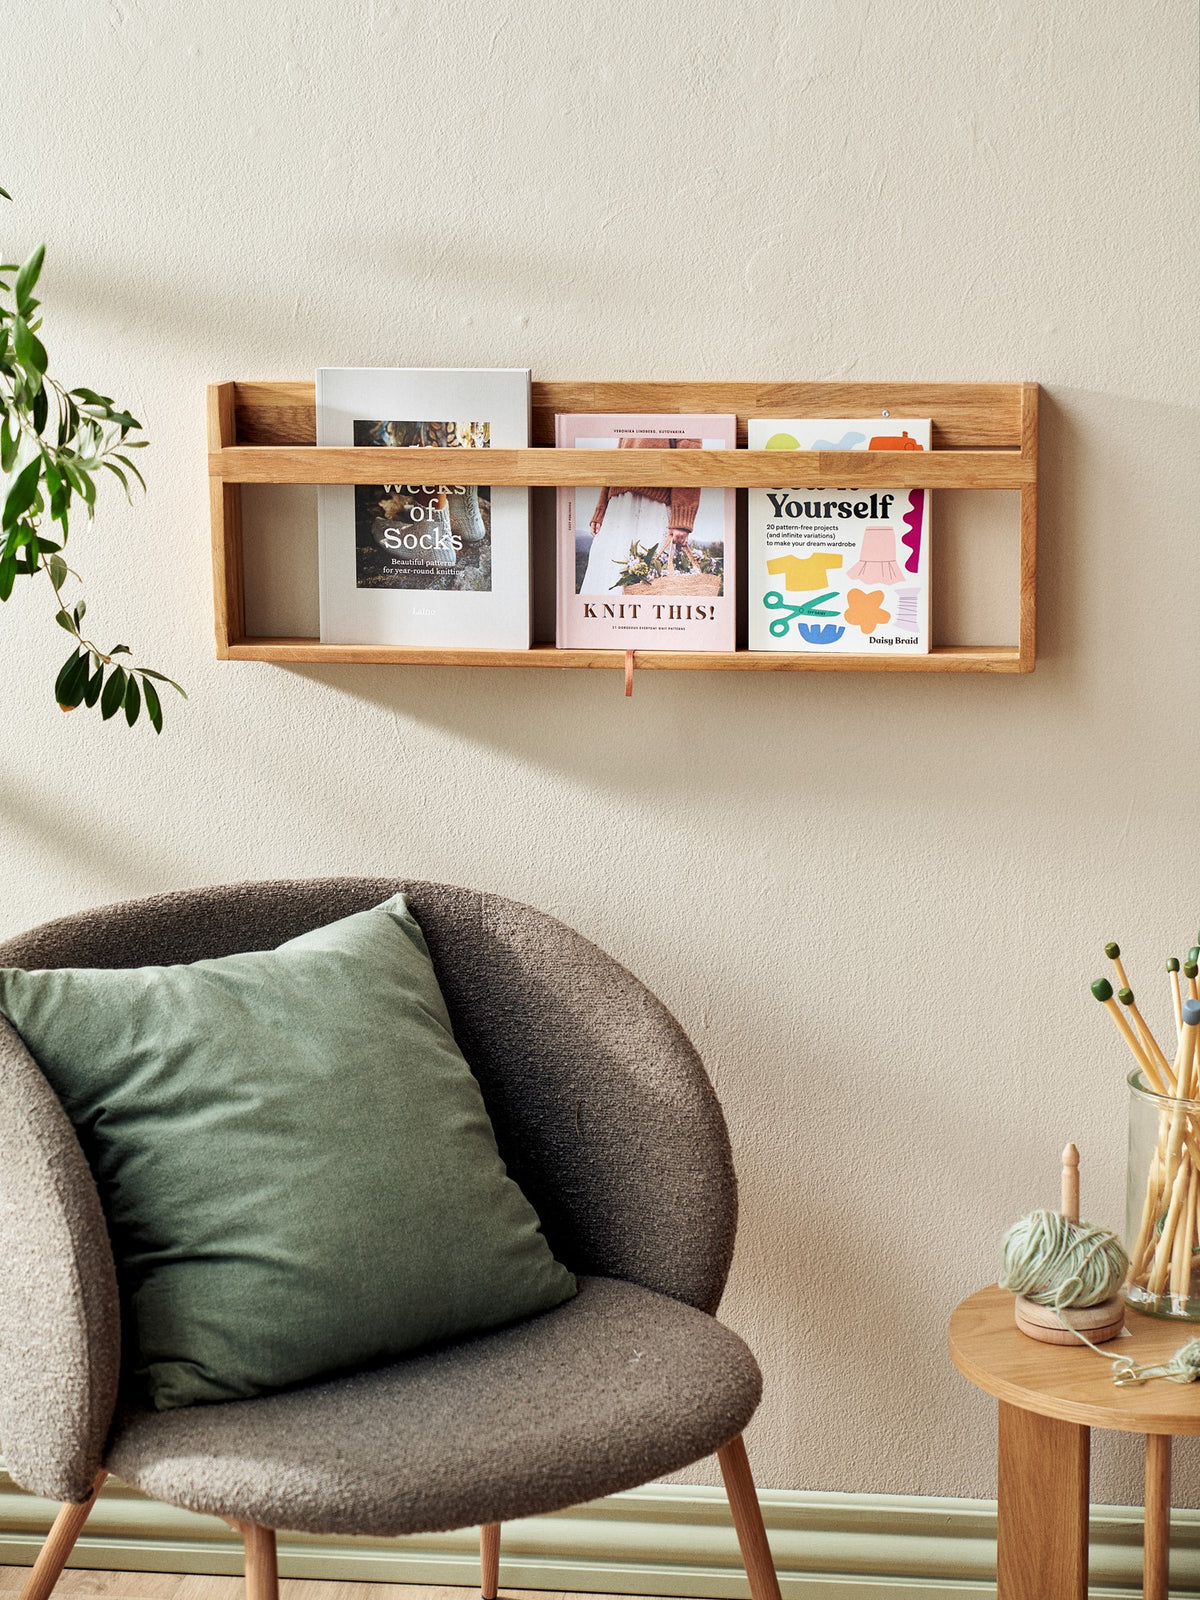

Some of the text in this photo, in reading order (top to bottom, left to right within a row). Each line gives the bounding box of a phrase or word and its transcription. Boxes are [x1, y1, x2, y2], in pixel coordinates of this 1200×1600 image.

[410, 499, 438, 522] of
[767, 493, 894, 519] Yourself
[383, 528, 463, 551] Socks
[391, 558, 455, 567] Beautiful patterns
[437, 568, 465, 577] knitting
[583, 603, 715, 620] KNIT THIS!
[869, 636, 918, 645] Daisy Braid
